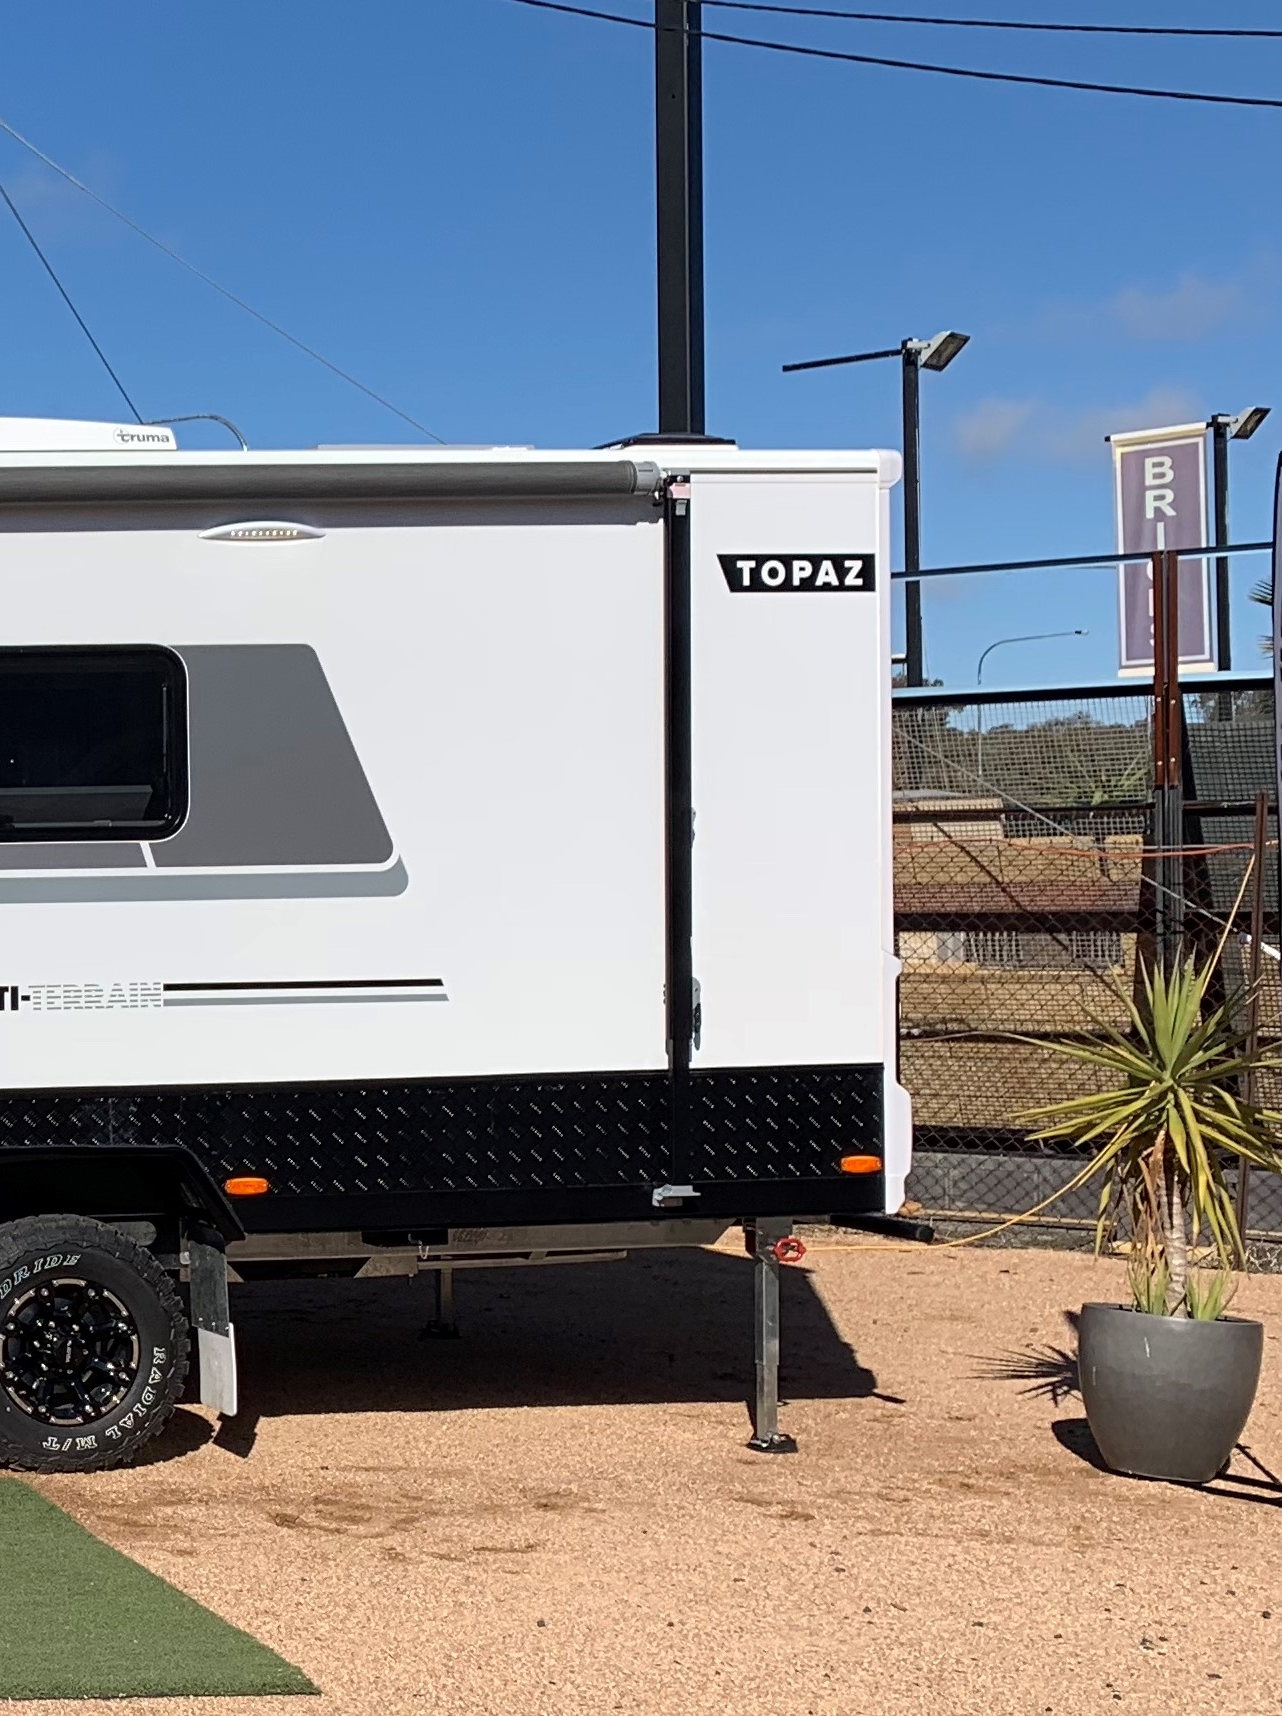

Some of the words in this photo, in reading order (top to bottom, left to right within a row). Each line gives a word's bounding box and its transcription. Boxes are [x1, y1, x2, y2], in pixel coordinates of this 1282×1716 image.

[116, 429, 170, 443] truma
[736, 559, 864, 587] TOPAZ
[104, 1346, 167, 1440] RADIAL
[42, 1435, 99, 1451] M/T
